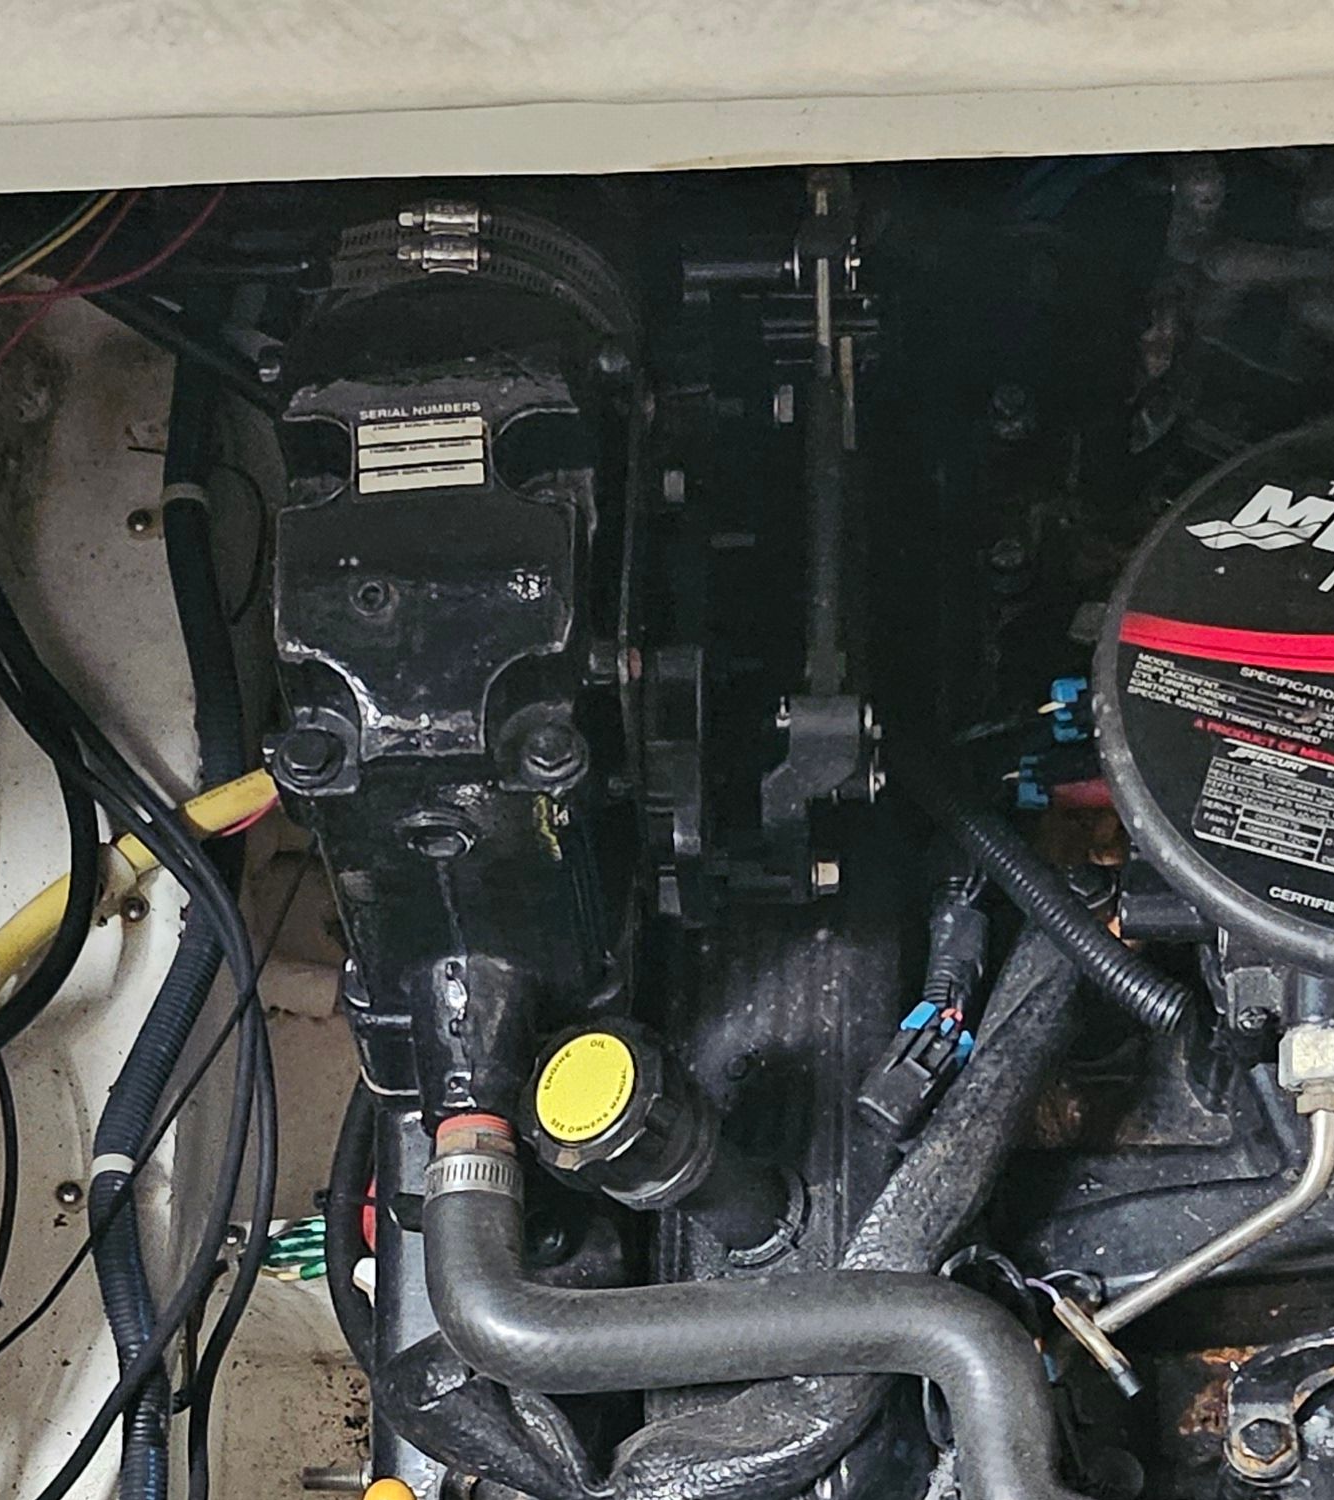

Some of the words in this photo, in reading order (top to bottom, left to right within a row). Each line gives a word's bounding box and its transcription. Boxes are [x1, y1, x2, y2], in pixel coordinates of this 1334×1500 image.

[359, 406, 409, 420] SERIAL
[412, 401, 481, 416] NUMBERS
[1128, 678, 1178, 697] IGNITION
[1179, 691, 1218, 707] TIMING
[1131, 669, 1157, 683] CYL.
[1158, 677, 1195, 693] FIRING
[1197, 687, 1237, 704] ORDER
[1134, 662, 1220, 690] DISPLACEMENT
[1137, 653, 1177, 669] MODEL
[1277, 691, 1307, 706] MCM
[1126, 685, 1174, 704] SPECIAL
[1174, 698, 1223, 718] IGNITION
[1225, 712, 1264, 730] TIMING
[1263, 723, 1322, 745] REQUIRED
[1193, 717, 1205, 729] A
[1206, 722, 1275, 748] PRODUCT
[1278, 740, 1298, 754] OF
[544, 1049, 572, 1091] ENGINE
[590, 1040, 606, 1049] OIL
[550, 1118, 566, 1132] SEE
